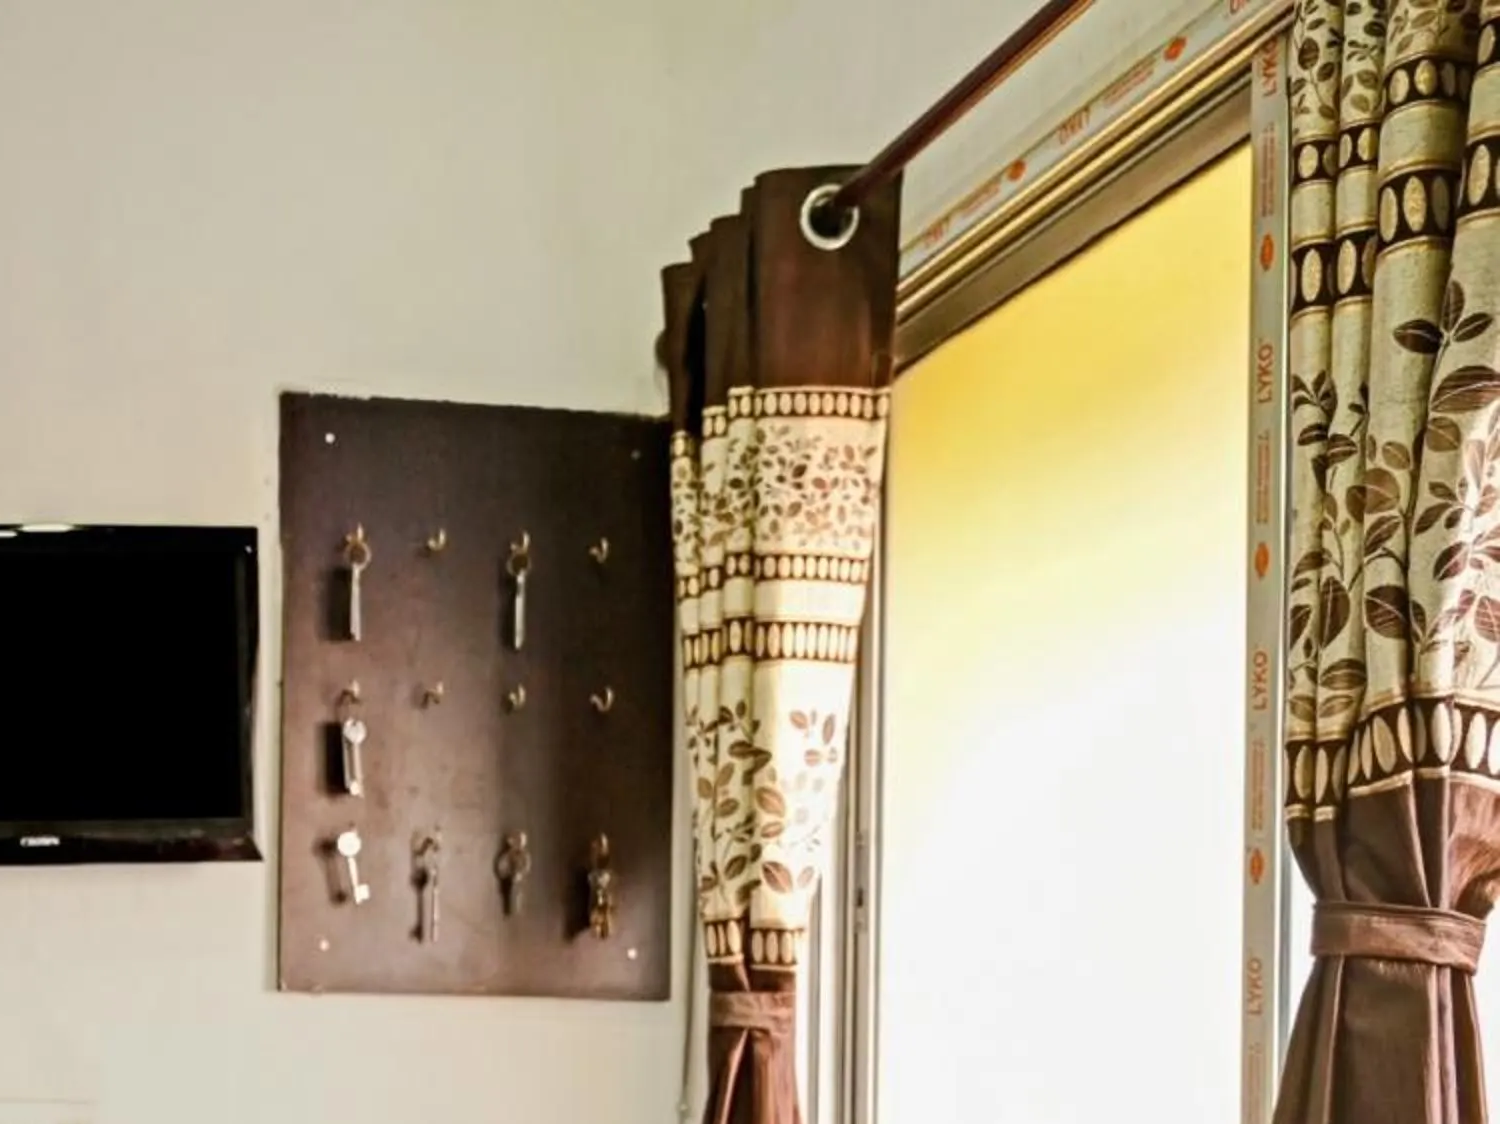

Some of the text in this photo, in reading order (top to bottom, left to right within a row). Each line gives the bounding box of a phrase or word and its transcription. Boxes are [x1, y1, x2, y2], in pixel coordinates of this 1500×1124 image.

[1257, 343, 1273, 404] LYKO
[1252, 650, 1268, 712] LYKO
[1247, 956, 1263, 1016] LYKO
